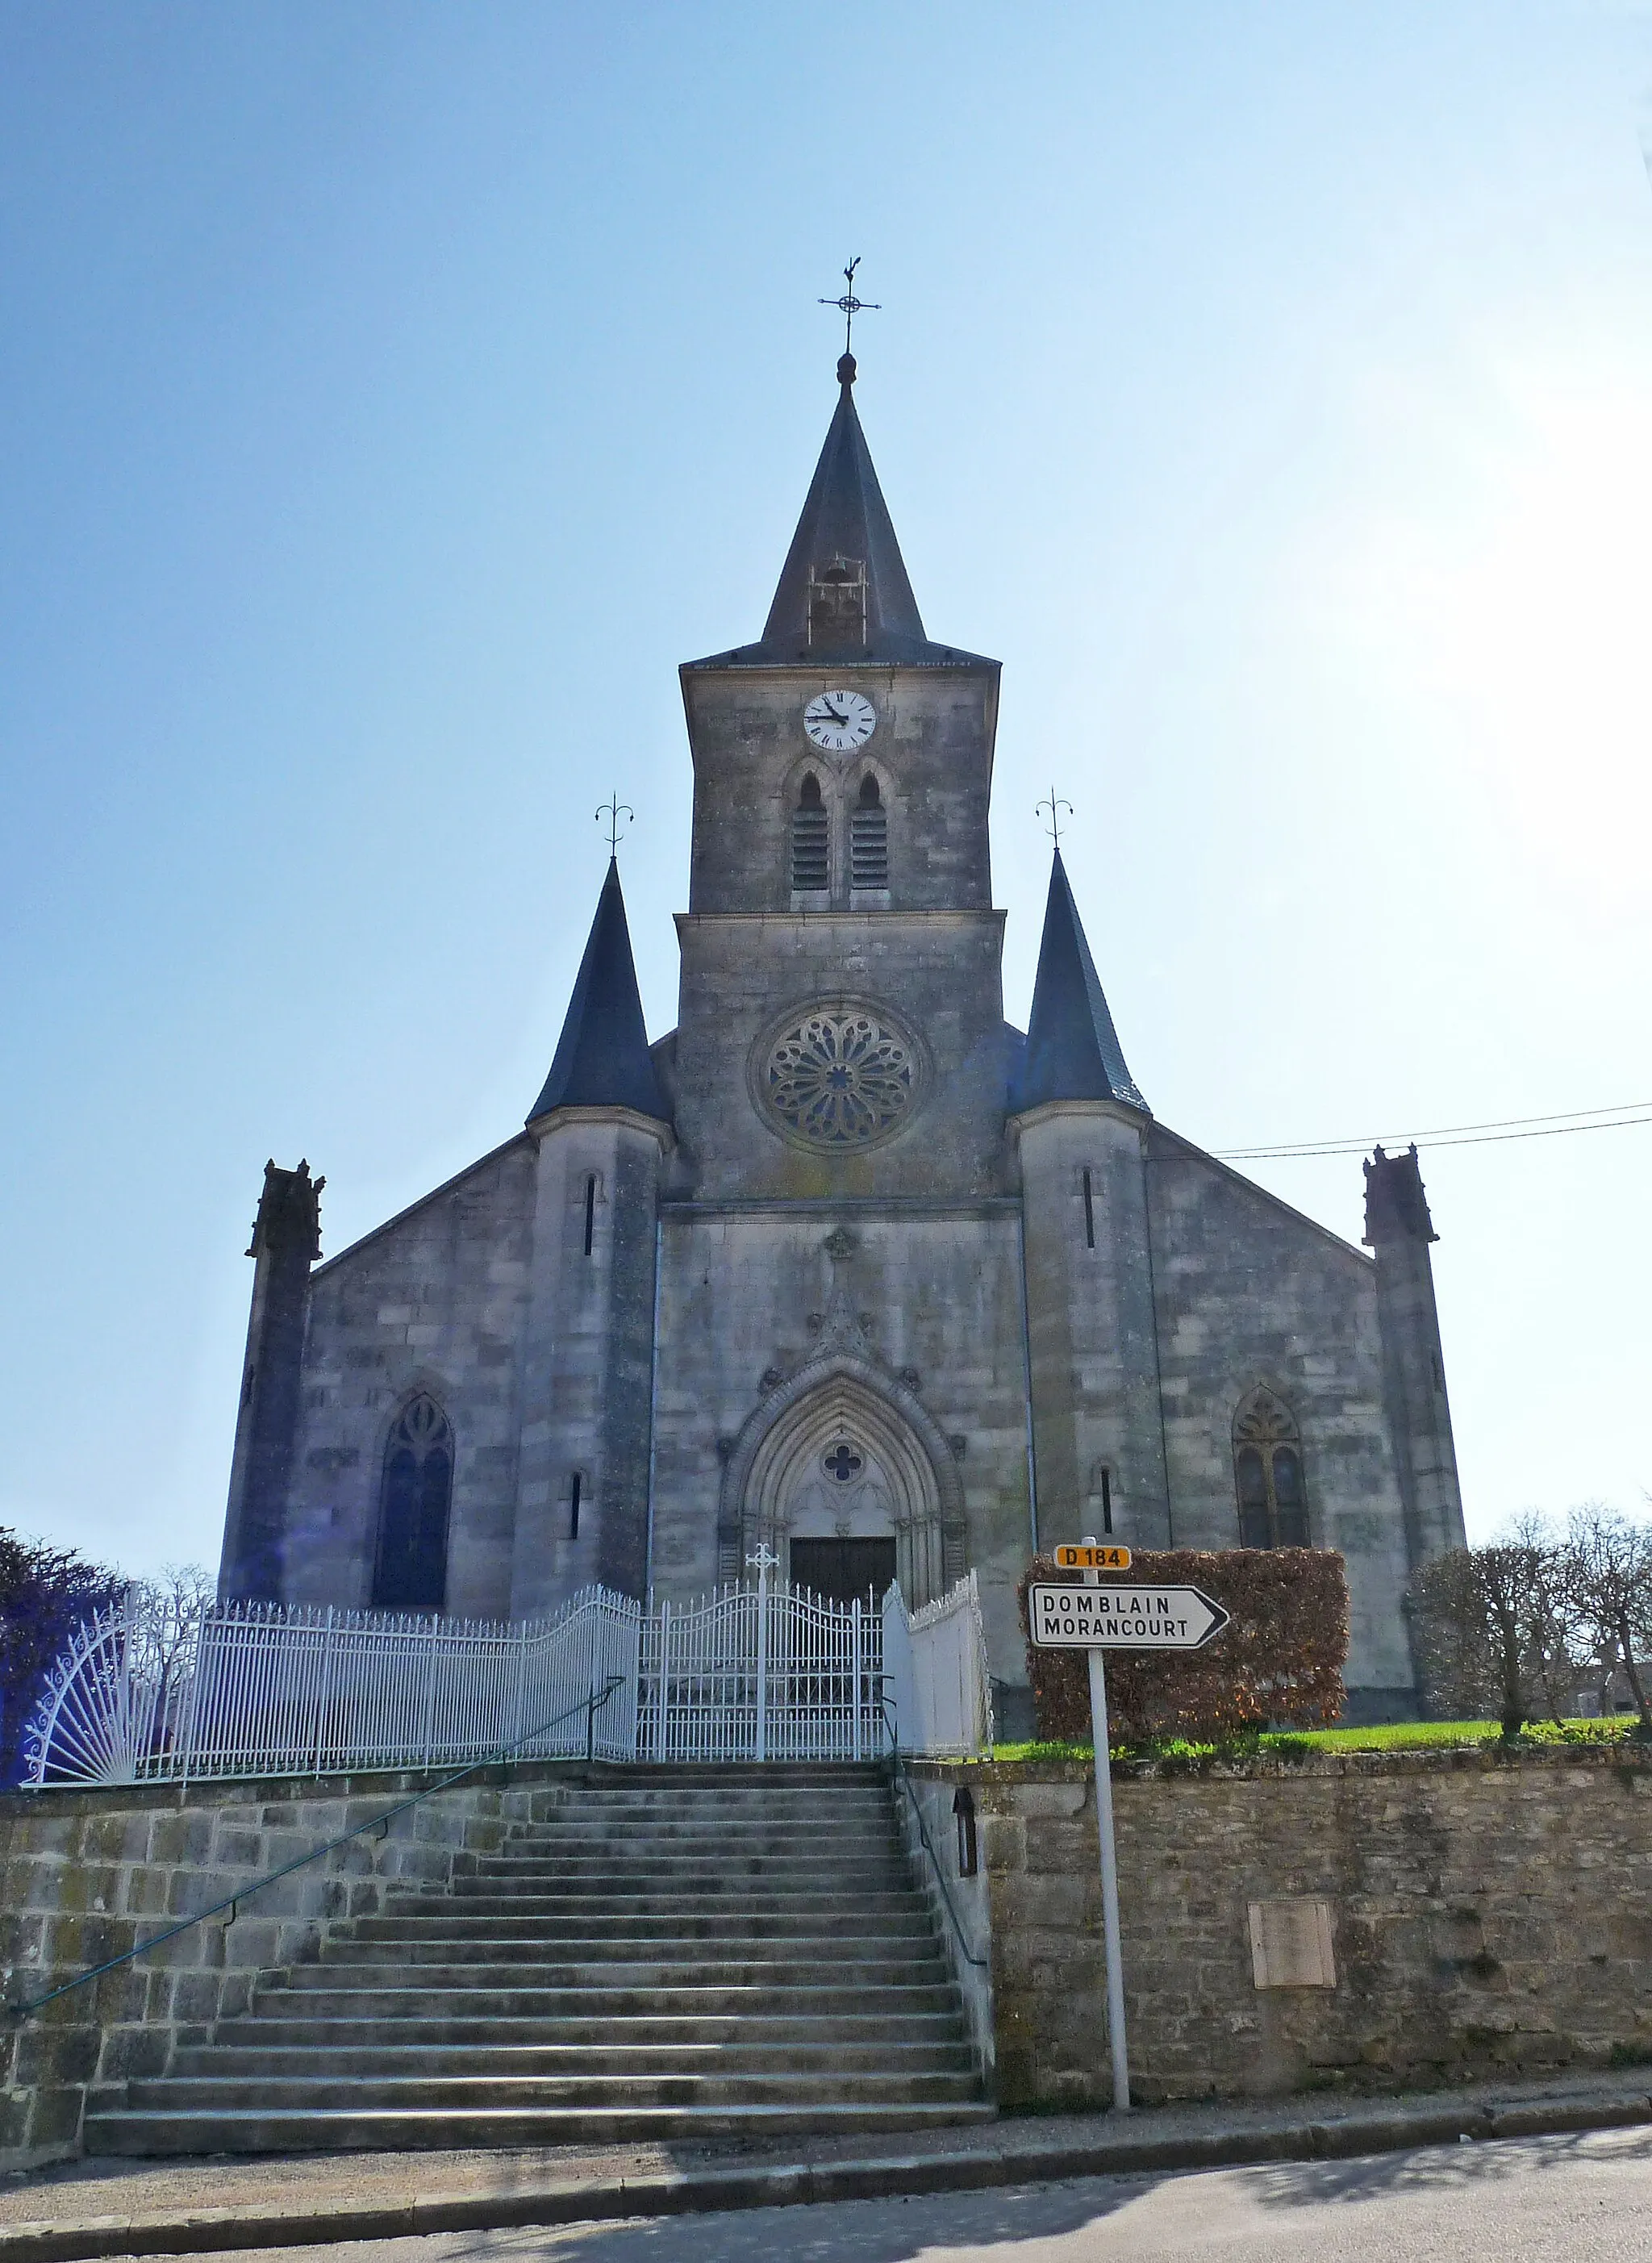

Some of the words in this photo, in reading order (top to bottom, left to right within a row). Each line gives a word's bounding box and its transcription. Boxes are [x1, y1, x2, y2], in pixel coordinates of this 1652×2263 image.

[1066, 1548, 1077, 1565] D
[1085, 1548, 1120, 1566] 184
[1043, 1595, 1169, 1614] DOMBLAIN
[1044, 1618, 1187, 1636] MORANCOURT
